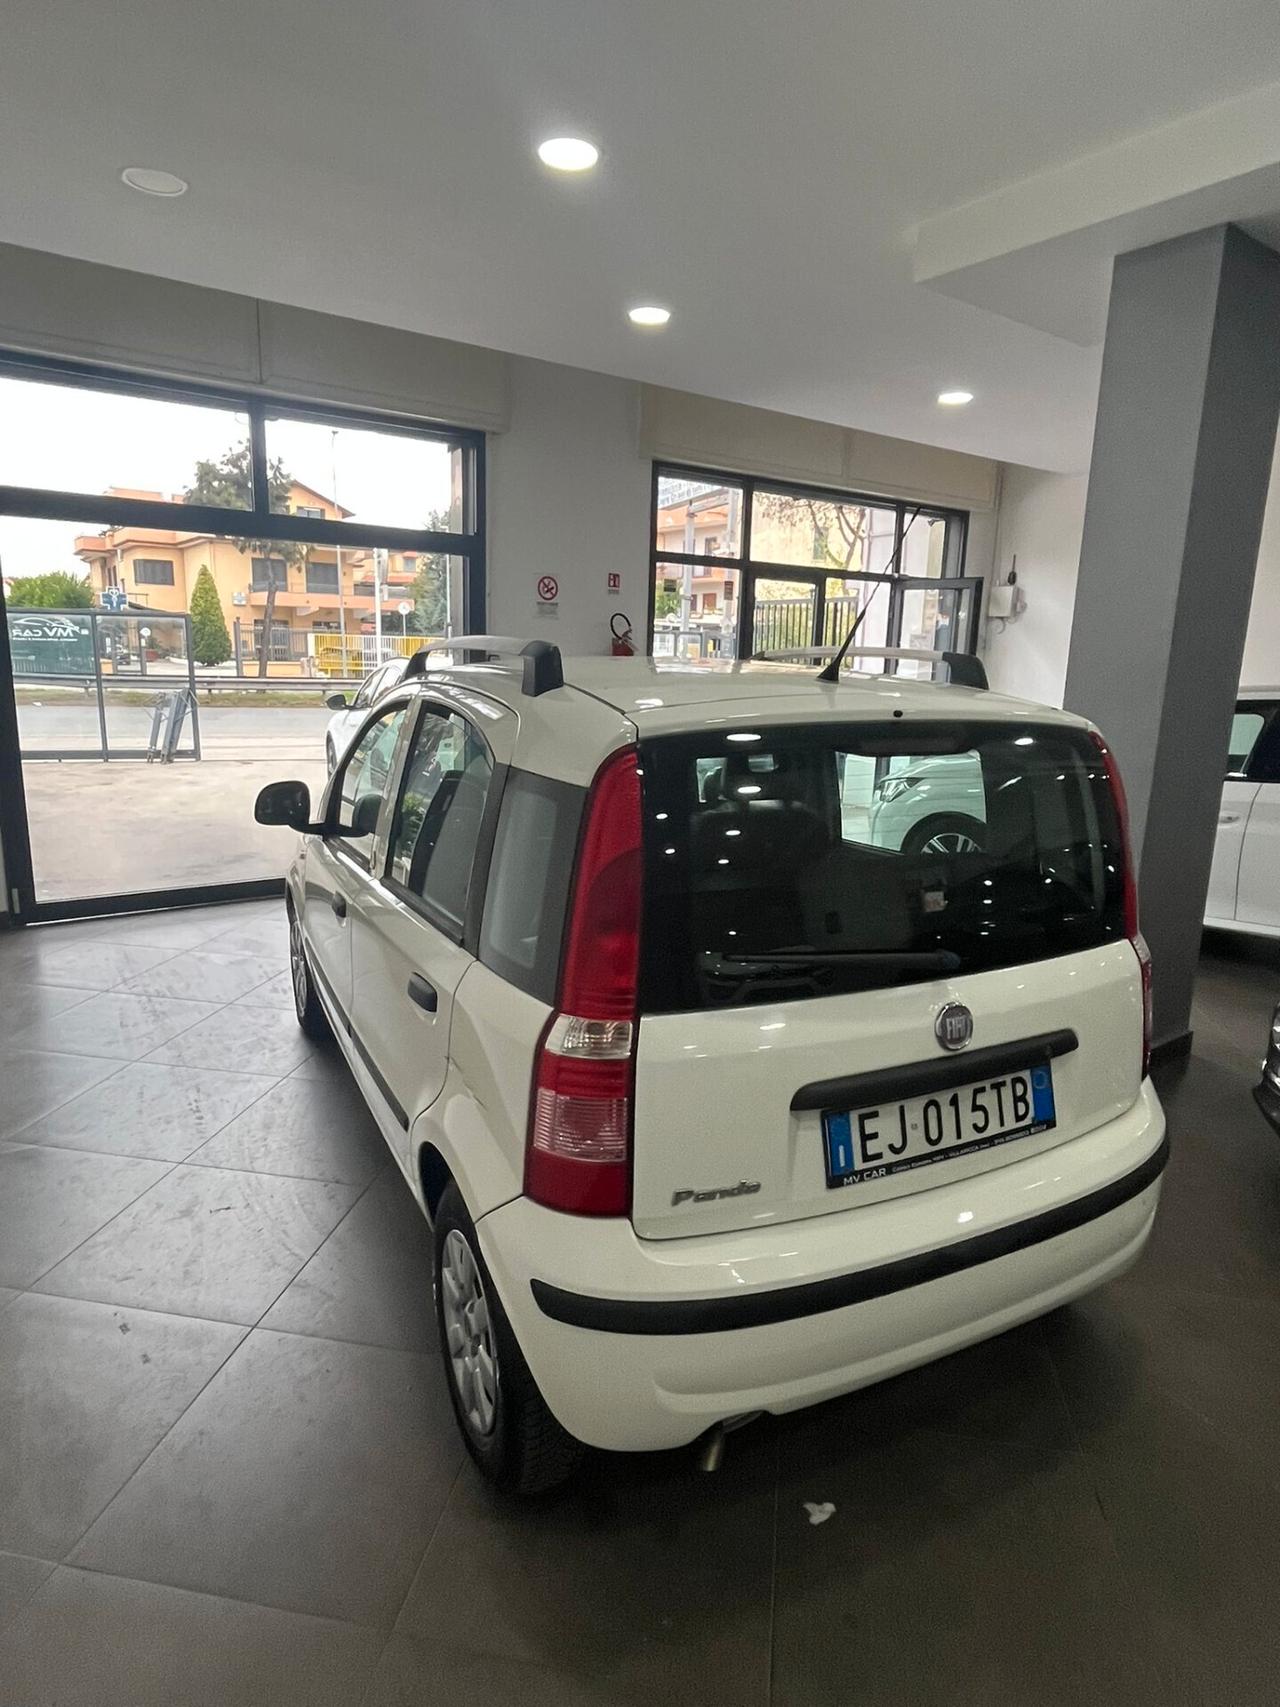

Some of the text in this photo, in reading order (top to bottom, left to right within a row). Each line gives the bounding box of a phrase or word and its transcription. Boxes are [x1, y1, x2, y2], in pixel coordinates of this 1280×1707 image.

[843, 1167, 887, 1186] MV CAR
[671, 1179, 762, 1207] Panda
